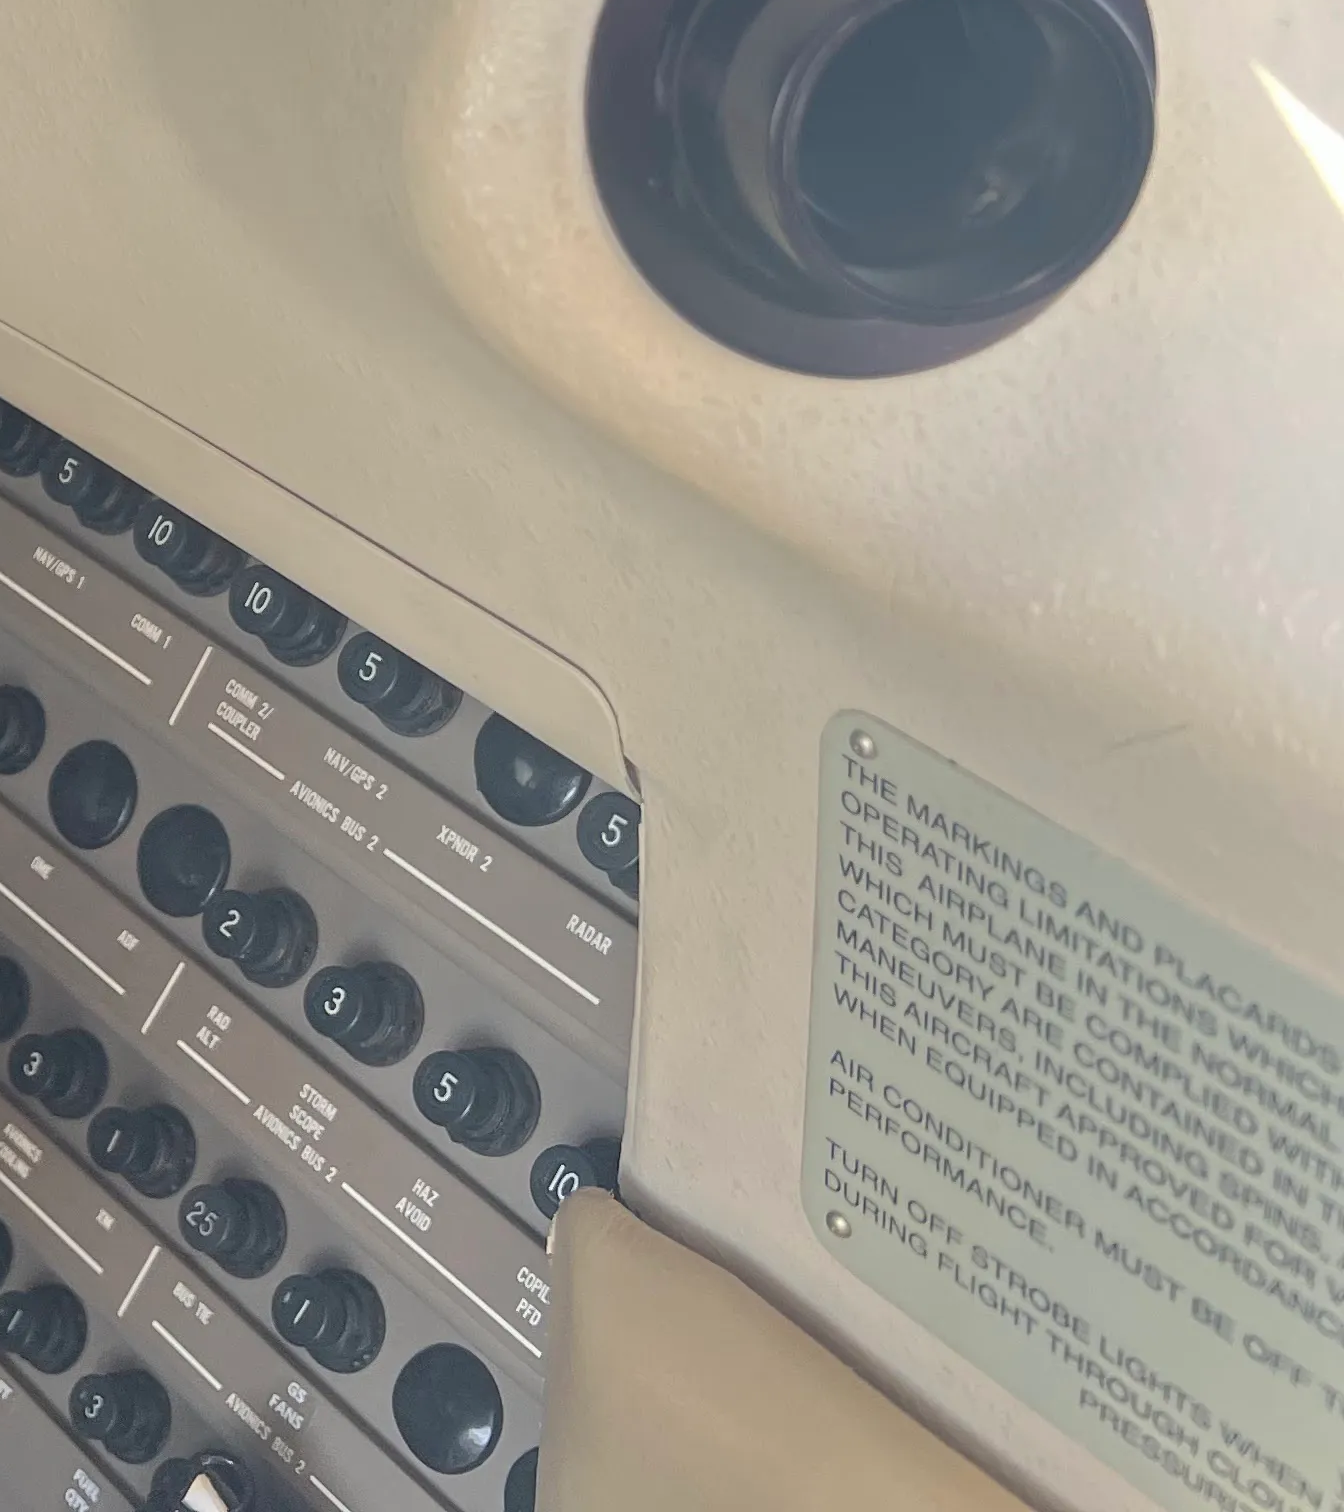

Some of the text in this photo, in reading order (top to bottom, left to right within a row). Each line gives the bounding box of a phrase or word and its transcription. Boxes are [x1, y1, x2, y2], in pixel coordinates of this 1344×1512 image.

[59, 458, 79, 483] 5
[148, 515, 172, 545] 10
[33, 546, 76, 583] NAV/GPS
[244, 582, 272, 614] 10
[130, 613, 161, 644] COMM
[359, 652, 382, 682] 5
[225, 679, 257, 710] COMM
[216, 702, 263, 740] COUPLER
[323, 747, 375, 792] NAV/GPS
[290, 780, 366, 842] AVIONICS BUS
[436, 825, 479, 863] XPNDR
[601, 814, 628, 847] 5
[841, 754, 1144, 955] THE MARKINGS AND
[220, 910, 240, 937] 2
[839, 821, 1107, 1009] THIS AIRPLANE IN
[840, 791, 1218, 1039] OPERATING LIMITATIONS
[566, 914, 613, 955] RADAR
[838, 853, 1077, 1024] WHICH MUST BE
[838, 888, 1065, 1051] CATEGORY ARE
[206, 1005, 231, 1031] RAD
[324, 988, 345, 1015] 3
[196, 1026, 221, 1050] ALT
[836, 919, 1209, 1180] MANEUVERS, INCLUDING
[23, 1052, 43, 1077] 3
[300, 1084, 338, 1122] STORM
[434, 1073, 458, 1102] 5
[833, 982, 1118, 1190] WHEN EQUIPPED IN
[835, 951, 1234, 1231] THIS AIRCRAFT APPROVED
[253, 1105, 325, 1172] AVIONICS BUS
[289, 1105, 326, 1141] SCOPE
[549, 1165, 579, 1200] 10
[829, 1077, 1057, 1254] PERFORMANCE.
[830, 1049, 1185, 1303] AIR CONDITIONER MUST
[412, 1179, 440, 1207] HAZ
[186, 1201, 219, 1236] 25
[395, 1198, 431, 1232] AVOID
[824, 1137, 1212, 1430] TURN OFF STROBE LIGHTS
[516, 1299, 541, 1327] PFD
[824, 1168, 928, 1258] DURING
[938, 1252, 1040, 1339] FLIGHT
[1045, 1327, 1199, 1457] THROUGH
[84, 1394, 104, 1419] 3
[225, 1393, 271, 1441] AVIONICS
[268, 1393, 305, 1431] FANS
